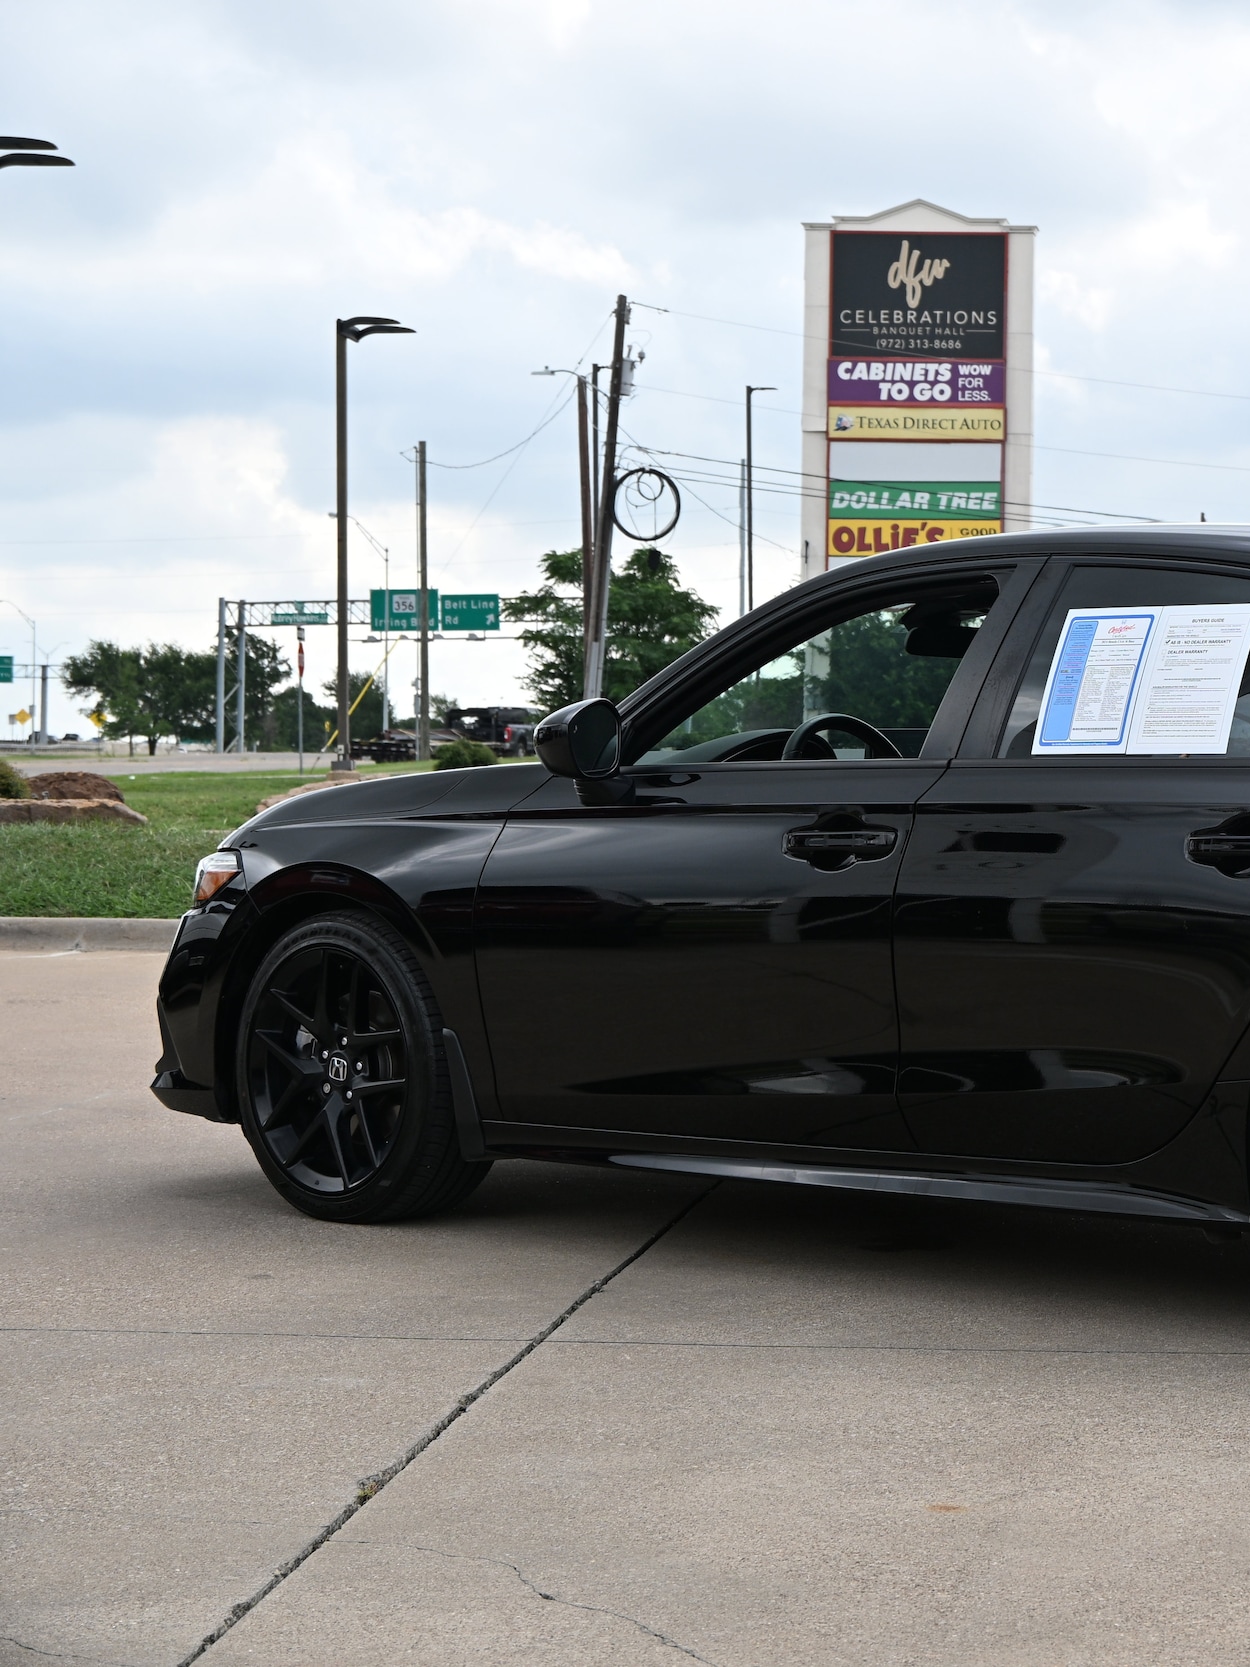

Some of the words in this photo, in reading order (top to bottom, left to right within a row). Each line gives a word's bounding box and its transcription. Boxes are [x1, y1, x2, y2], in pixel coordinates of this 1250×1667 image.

[887, 239, 951, 309] dfw
[839, 309, 998, 325] CELEBRATIONS
[872, 326, 931, 335] BANQUET
[935, 327, 966, 336] HALL
[876, 339, 906, 350] (972)
[908, 339, 962, 349] 313-8686
[837, 361, 952, 382] CABINETS
[958, 364, 992, 376] WOW
[958, 377, 984, 389] FOR
[878, 382, 910, 401] TO
[912, 382, 952, 402] GO
[958, 391, 992, 402] LESS.
[832, 491, 930, 510] DOLLAR
[936, 492, 998, 510] TREE
[394, 601, 415, 611] 356
[444, 600, 467, 609] Belt
[471, 600, 495, 609] Line
[445, 616, 459, 625] Rd
